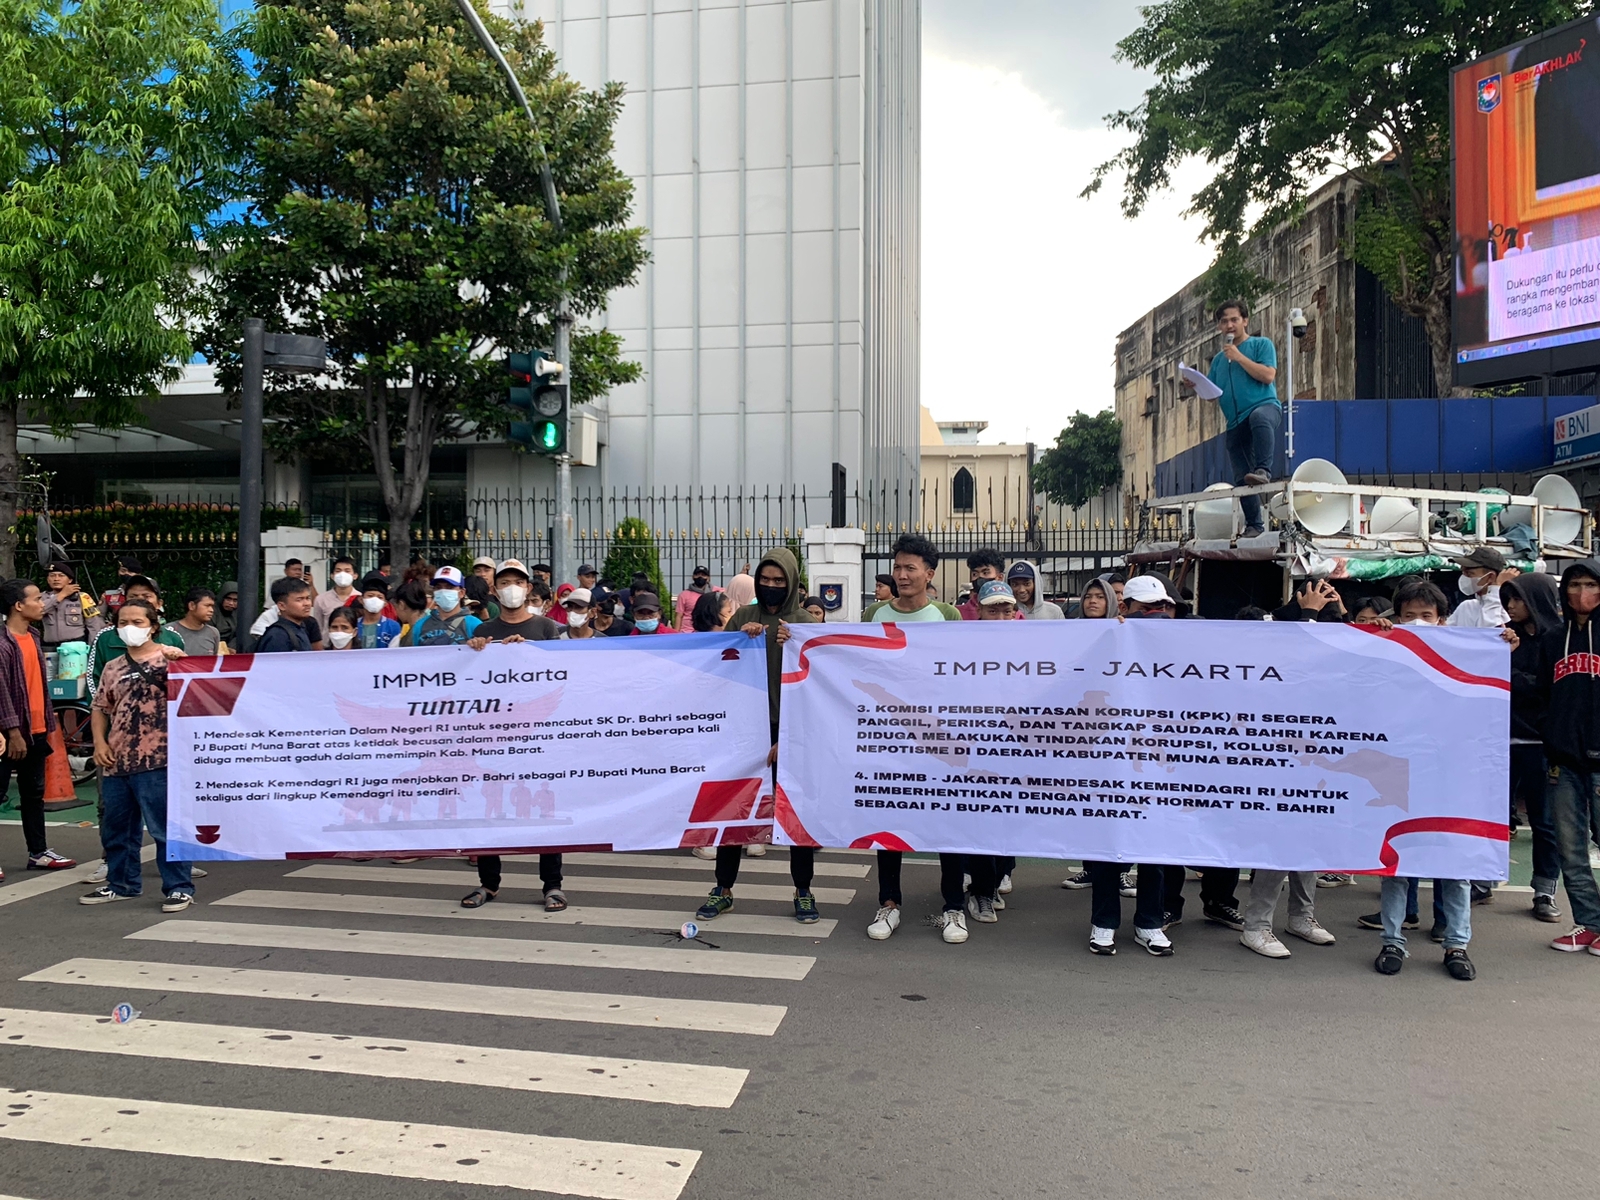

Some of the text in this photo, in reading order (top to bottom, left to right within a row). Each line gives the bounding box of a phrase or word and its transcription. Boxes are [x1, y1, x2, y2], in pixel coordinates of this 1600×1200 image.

[1506, 273, 1553, 290] Dukungan
[1555, 269, 1567, 280] itu
[1570, 263, 1594, 279] perlu
[1506, 277, 1600, 305] rangka mengemban
[1506, 291, 1598, 319] beragama ke lokasi
[1568, 412, 1590, 438] BNI
[1555, 444, 1573, 459] ATM
[373, 672, 456, 689] IMPMB
[481, 669, 567, 684] Jakarta
[934, 662, 1056, 675] IMPMB
[1102, 661, 1284, 682] JAKARTA
[1553, 652, 1600, 684] ERIG
[204, 730, 265, 739] Mendesak
[268, 728, 346, 737] Kementerian
[350, 726, 387, 735] Dalam
[391, 725, 432, 735] Negeri
[489, 722, 530, 731] segera
[534, 718, 593, 727] mencabut
[597, 716, 614, 725] SK
[618, 716, 635, 724] Dr.
[639, 714, 672, 723] Bahri
[676, 711, 726, 721] sebagai
[876, 705, 932, 713] KOMISI
[938, 706, 1089, 716] PEMBERANTASAN
[1095, 708, 1174, 719] KORUPSI
[1179, 711, 1231, 723] (KPK)
[1237, 713, 1255, 722] RI
[1262, 714, 1337, 725] SEGERA
[209, 743, 247, 752] Bupati
[403, 735, 453, 743] becusan
[456, 735, 493, 743] dalam
[497, 734, 554, 743] mengurus
[557, 730, 601, 739] daerah
[605, 729, 628, 737] dan
[631, 727, 694, 736] beberapa
[698, 724, 719, 733] kali
[857, 718, 1388, 742] PANGGIL, PERIKSA, DAN TANGKAP SAUDARA BAHRI KARENA
[857, 731, 1343, 755] DIDUGA MELAKUKAN TINDAKAN KORUPSI, KOLUSI, DAN
[194, 756, 231, 765] diduga
[235, 755, 291, 763] membuat
[295, 753, 332, 763] gaduh
[335, 752, 372, 760] dalam
[375, 750, 436, 759] memimpin
[440, 749, 468, 757] Kab.
[472, 748, 504, 756] Muna
[857, 745, 1294, 767] NEPOTISME DI DAERAH KABUPATEN MUNA BARAT.
[195, 781, 203, 789] 2.
[207, 780, 264, 789] Mendesak
[268, 778, 341, 788] Kemendagri
[361, 777, 388, 787] juga
[392, 775, 458, 785] menjobkan
[483, 773, 514, 781] Bahri
[519, 770, 566, 781] sebagai
[570, 770, 584, 778] PJ
[588, 768, 627, 778] Bupati
[631, 767, 666, 775] Muna
[670, 765, 705, 773] Barat
[855, 772, 868, 780] 4.
[874, 772, 927, 782] IMPMB
[942, 775, 1022, 785] JAKARTA
[1027, 777, 1125, 789] MENDESAK
[1131, 781, 1251, 795] KEMENDAGRI
[1258, 787, 1275, 796] RI
[1282, 788, 1349, 800] UNTUK
[196, 787, 460, 803] sekaligus dari lingkup Kemendagri itu sendiri.
[855, 785, 1334, 814] MEMBERHENTIKAN DENGAN TIDAK HORMAT DR. BAHRI
[854, 799, 1147, 819] SEBAGAI PJ BUPATI MUNA BARAT.
